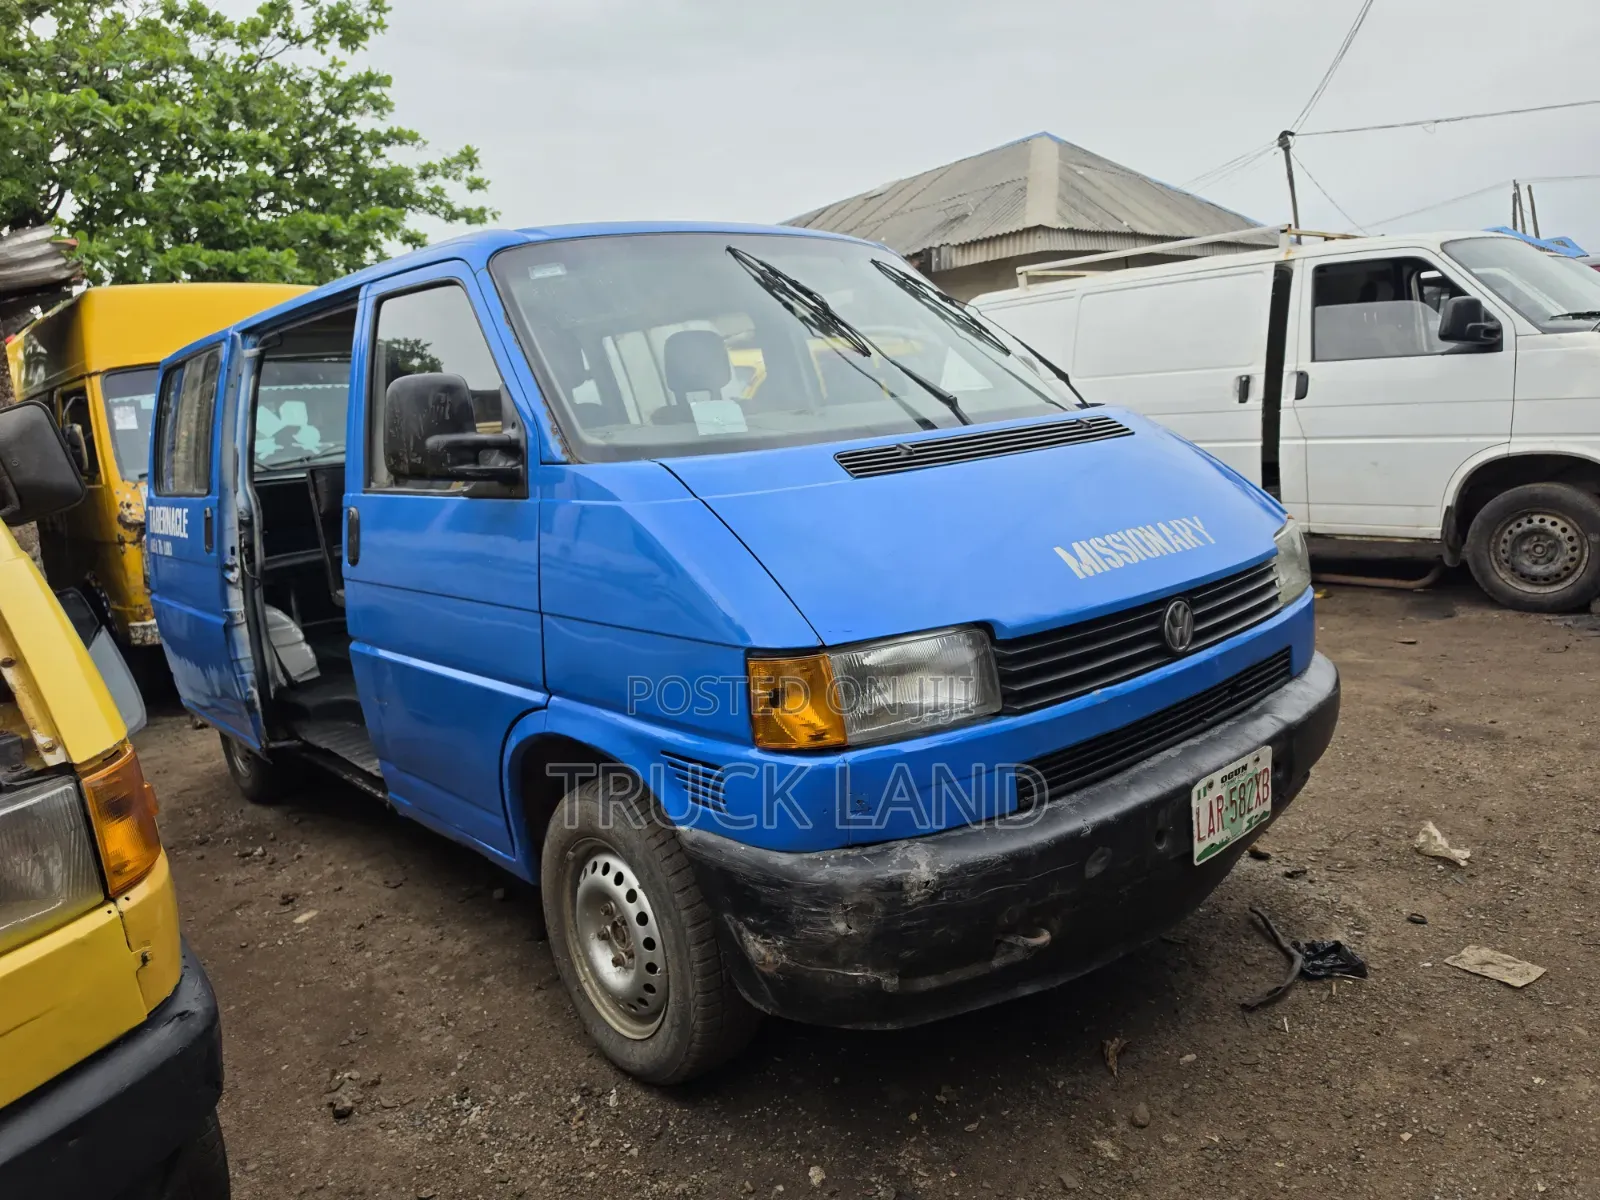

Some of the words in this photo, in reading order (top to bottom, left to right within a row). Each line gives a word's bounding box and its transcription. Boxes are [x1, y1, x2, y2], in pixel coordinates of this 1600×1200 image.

[148, 506, 188, 538] TABERNACLE
[1053, 516, 1216, 579] MISSIONARY
[1220, 763, 1248, 783] OGUN
